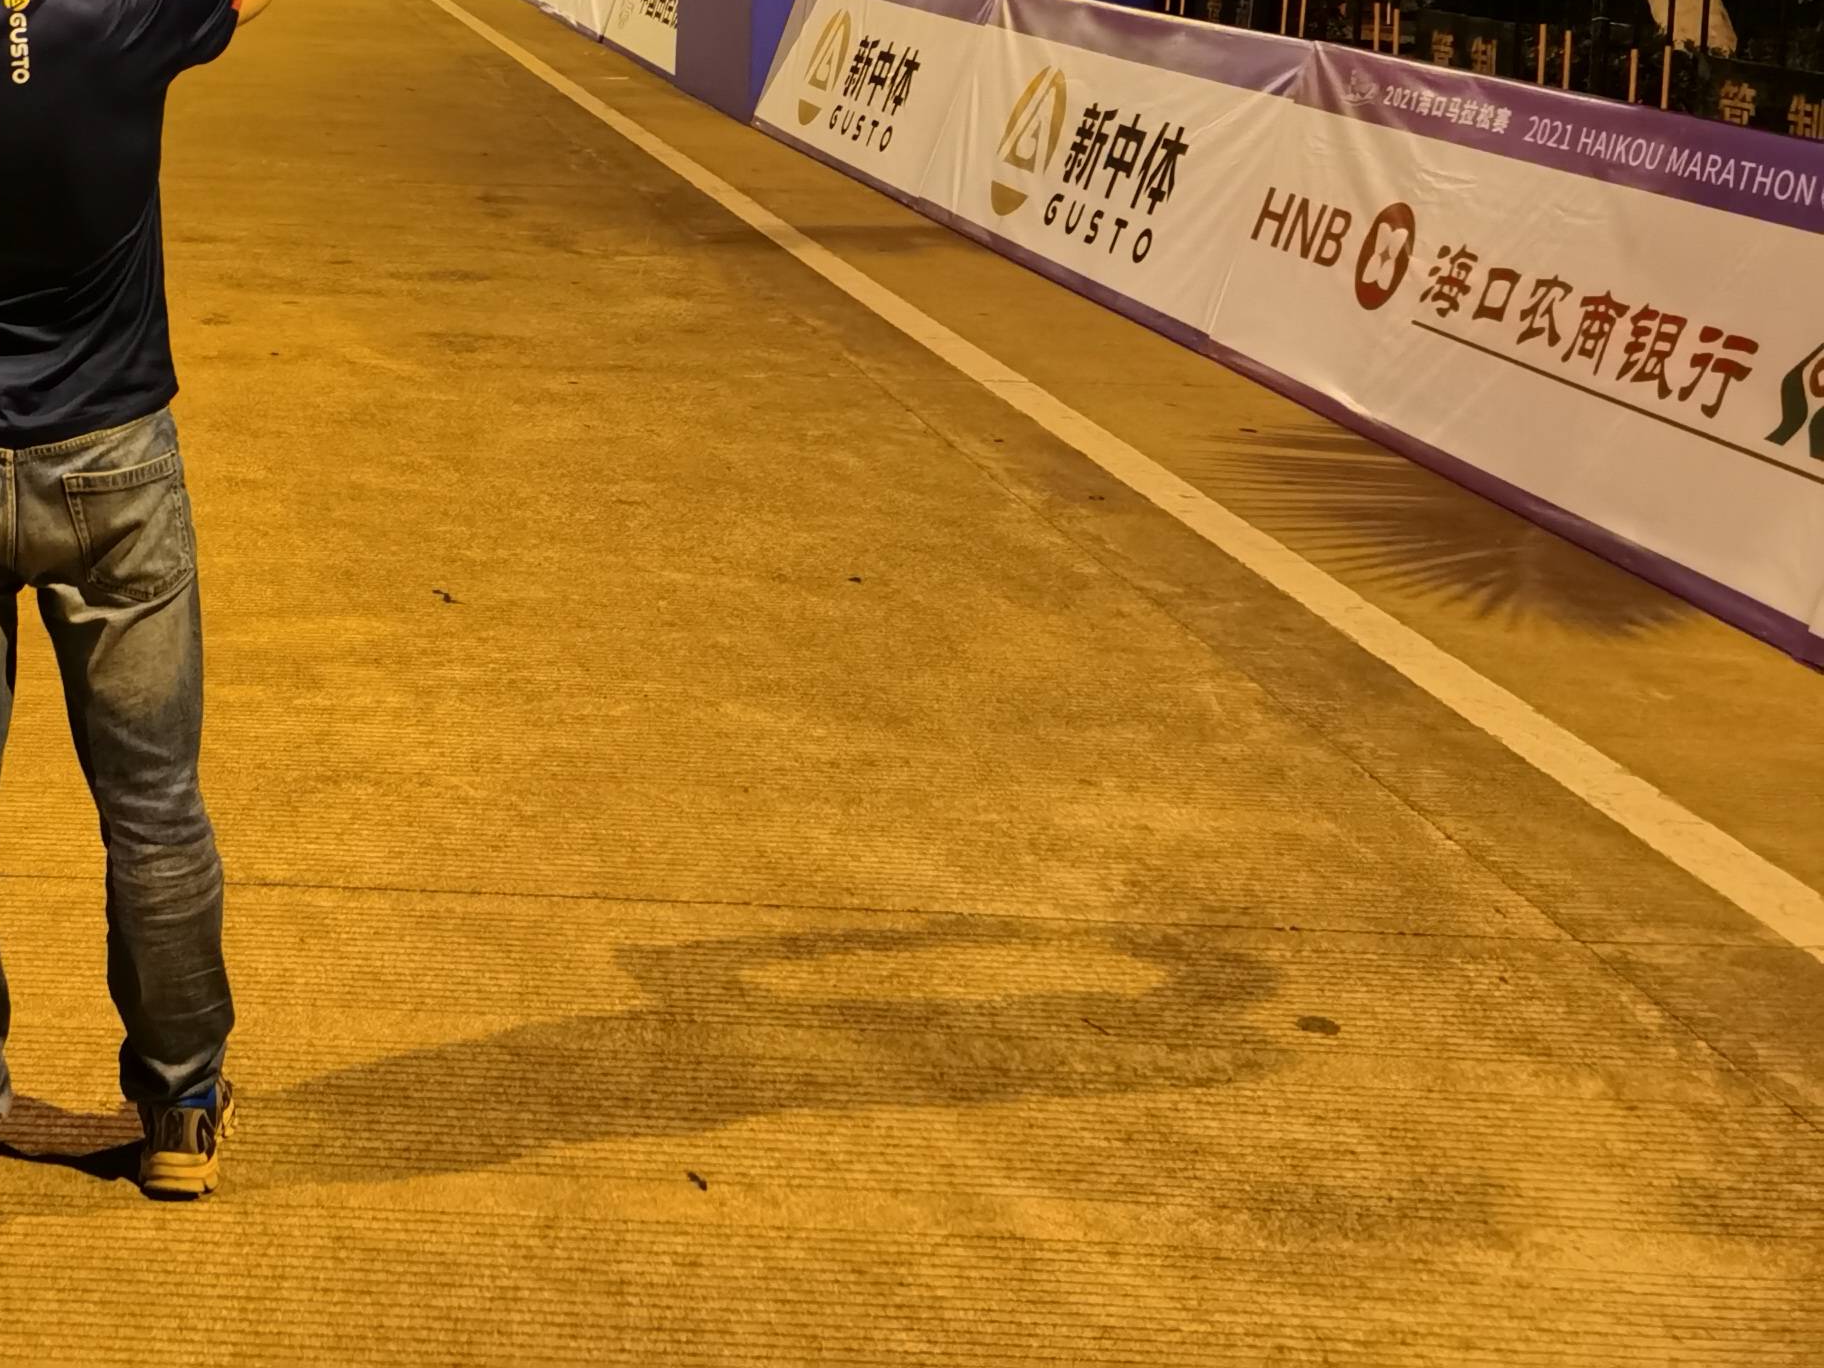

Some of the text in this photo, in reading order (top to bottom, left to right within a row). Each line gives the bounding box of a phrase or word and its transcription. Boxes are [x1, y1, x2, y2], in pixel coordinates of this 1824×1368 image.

[9, 12, 31, 85] GUSTO
[843, 36, 921, 116] 新中体
[829, 104, 893, 153] GUSTO
[1063, 102, 1190, 216] 新中体
[1524, 116, 1817, 207] 2021 HAIKOU MARATHON
[1044, 193, 1153, 264] GUSTO
[1251, 186, 1353, 267] HNB
[1420, 242, 1760, 419] 海口农商银行
